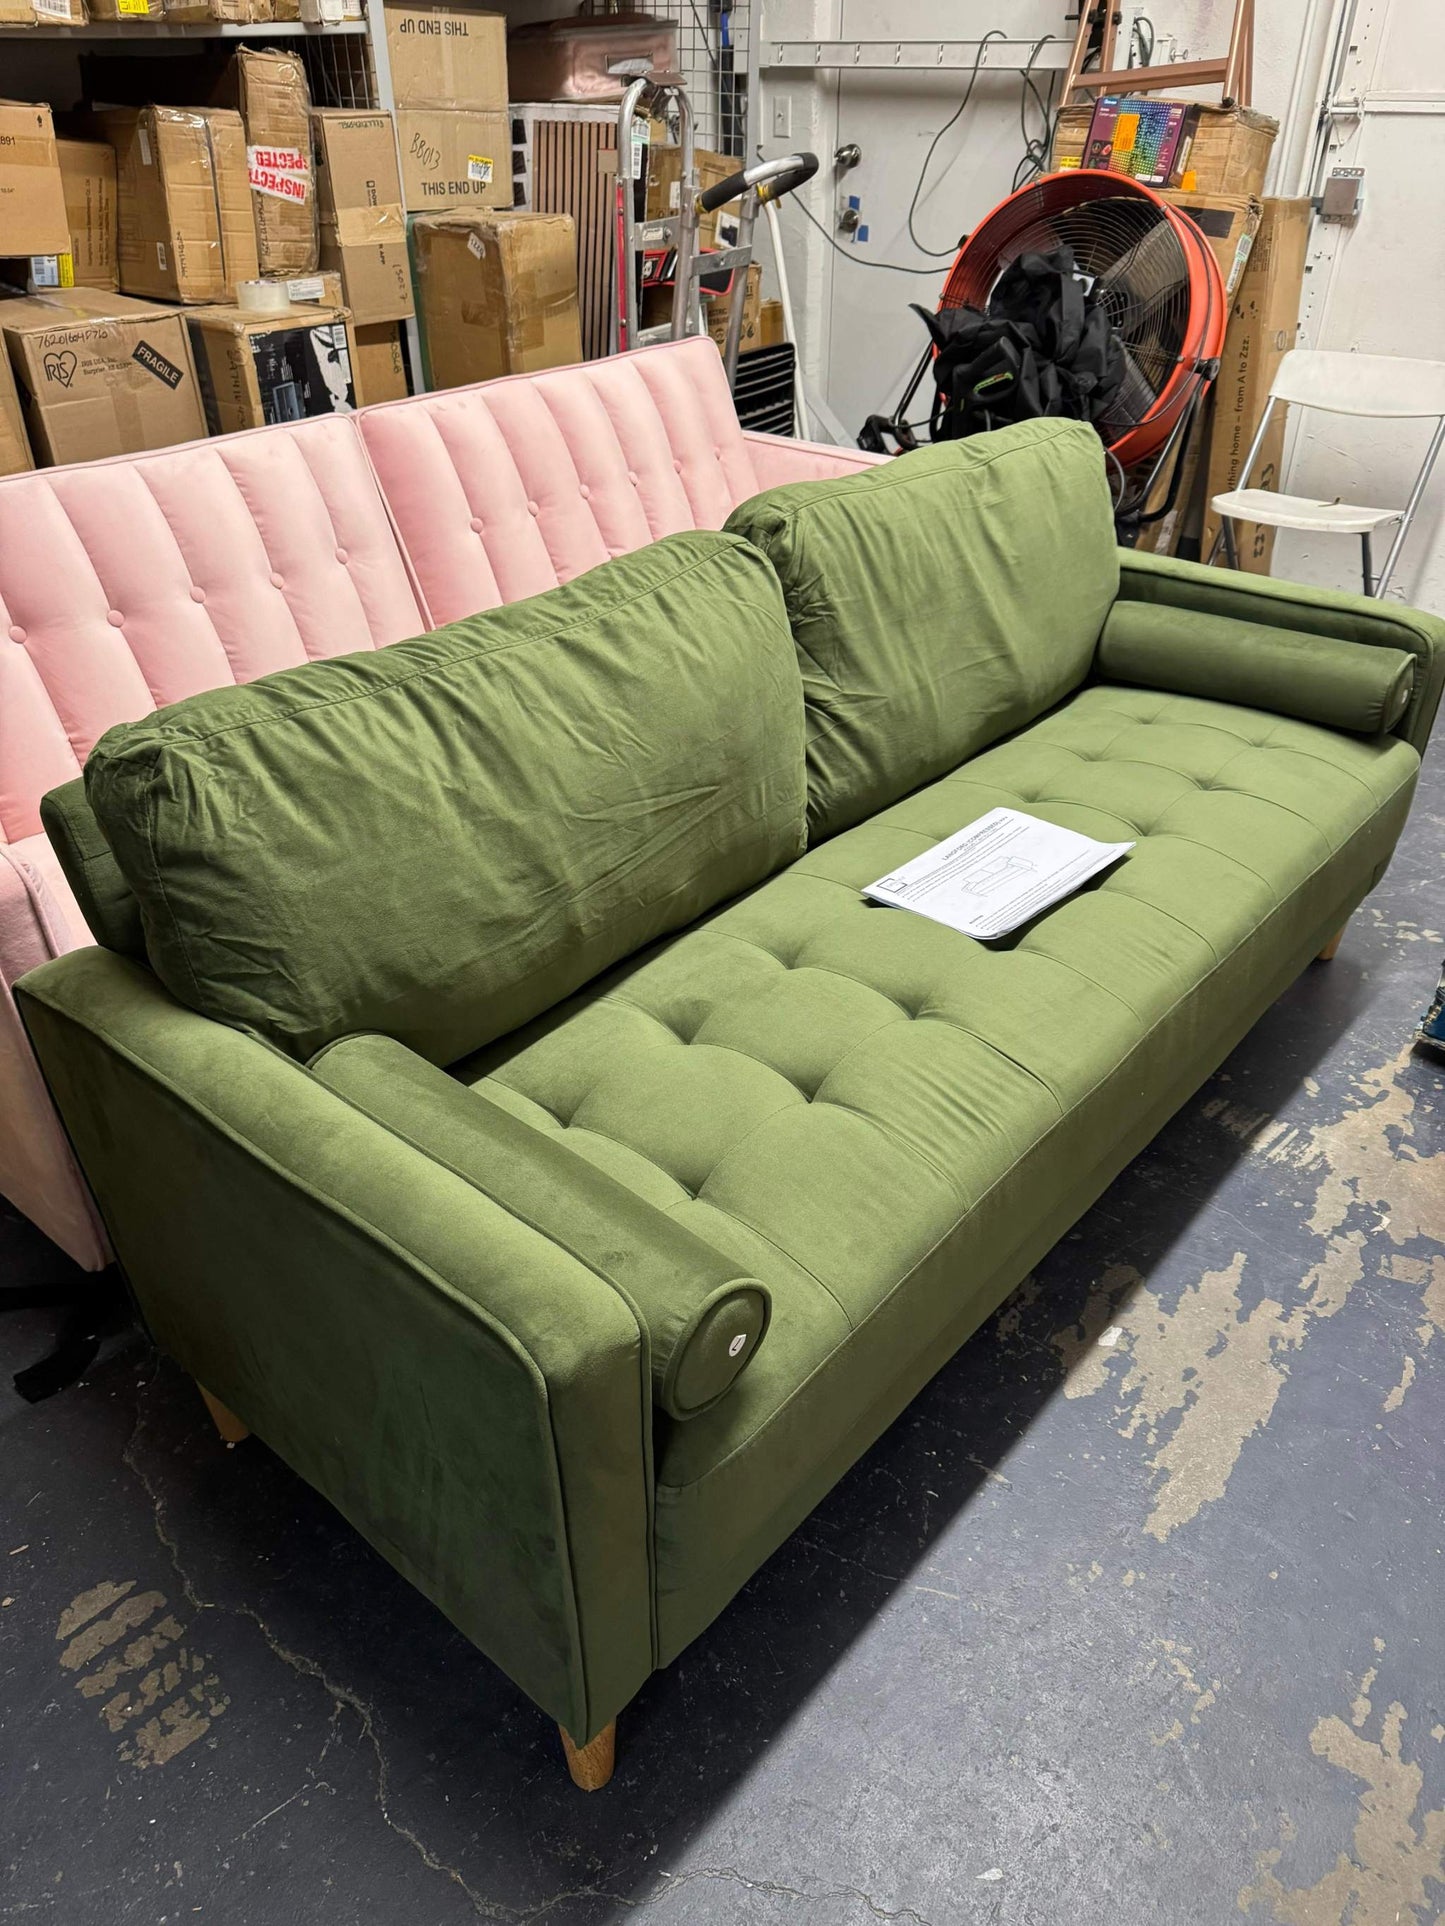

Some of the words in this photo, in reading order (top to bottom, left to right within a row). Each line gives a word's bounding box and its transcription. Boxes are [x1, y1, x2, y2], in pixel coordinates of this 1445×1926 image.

[400, 19, 415, 33] UP
[418, 19, 441, 35] END
[445, 21, 469, 36] THIS
[0, 136, 16, 146] 891
[421, 182, 446, 196] THIS
[449, 181, 470, 194] END
[473, 180, 486, 194] UP
[137, 346, 179, 384] FRAGILE
[1238, 361, 1248, 373] to
[1240, 375, 1248, 385] A
[1234, 386, 1245, 412] from
[1230, 425, 1241, 456] home
[1227, 460, 1239, 491] ything
